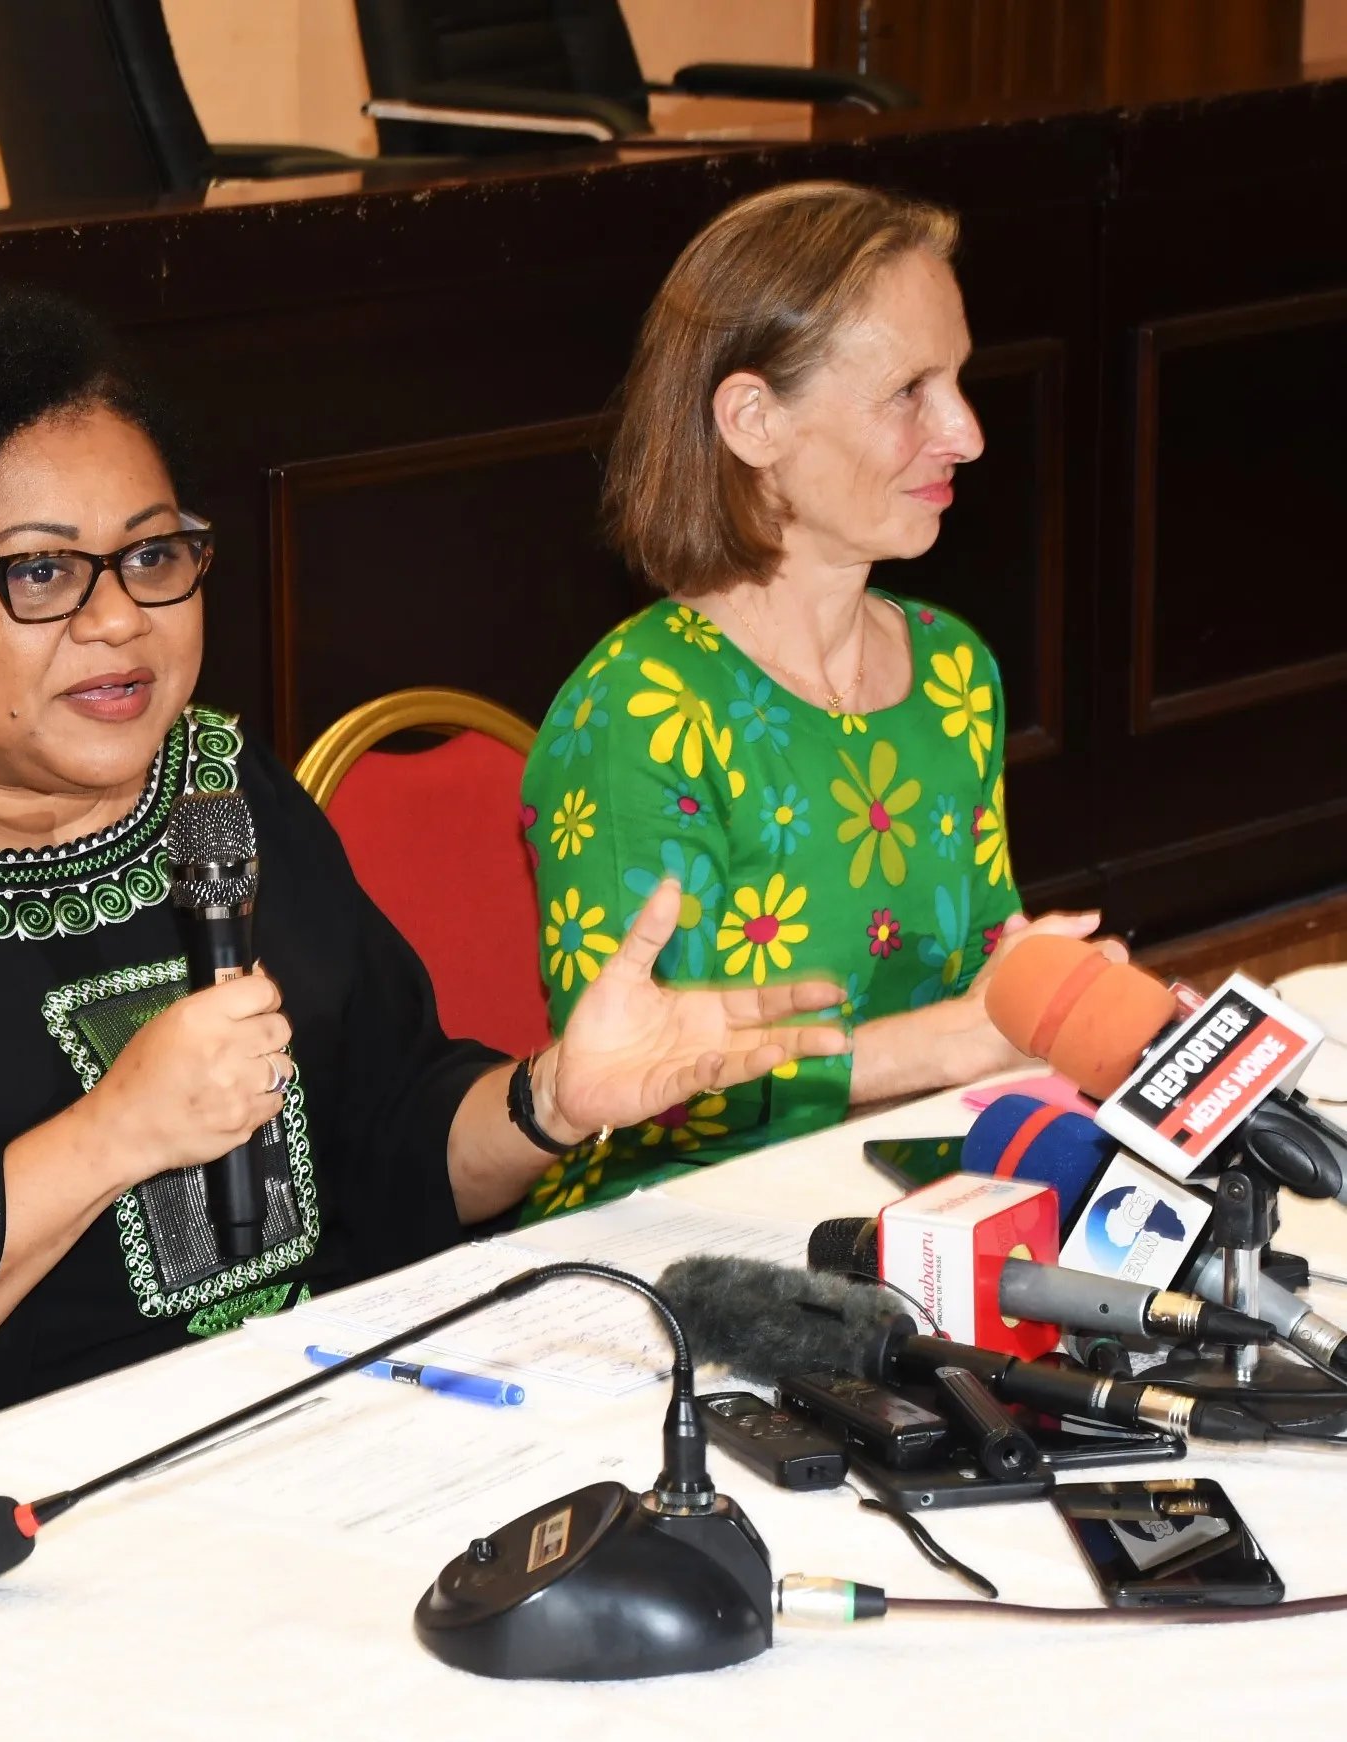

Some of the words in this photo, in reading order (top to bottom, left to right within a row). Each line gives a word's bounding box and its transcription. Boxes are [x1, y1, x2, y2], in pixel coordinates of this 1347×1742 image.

[1139, 1007, 1250, 1110] REPORTER
[1183, 1080, 1243, 1134] MÉDIAS
[1229, 1035, 1287, 1088] MONDE
[1122, 1189, 1157, 1228] C3
[936, 1285, 943, 1295] DE
[936, 1296, 944, 1326] GROUPE
